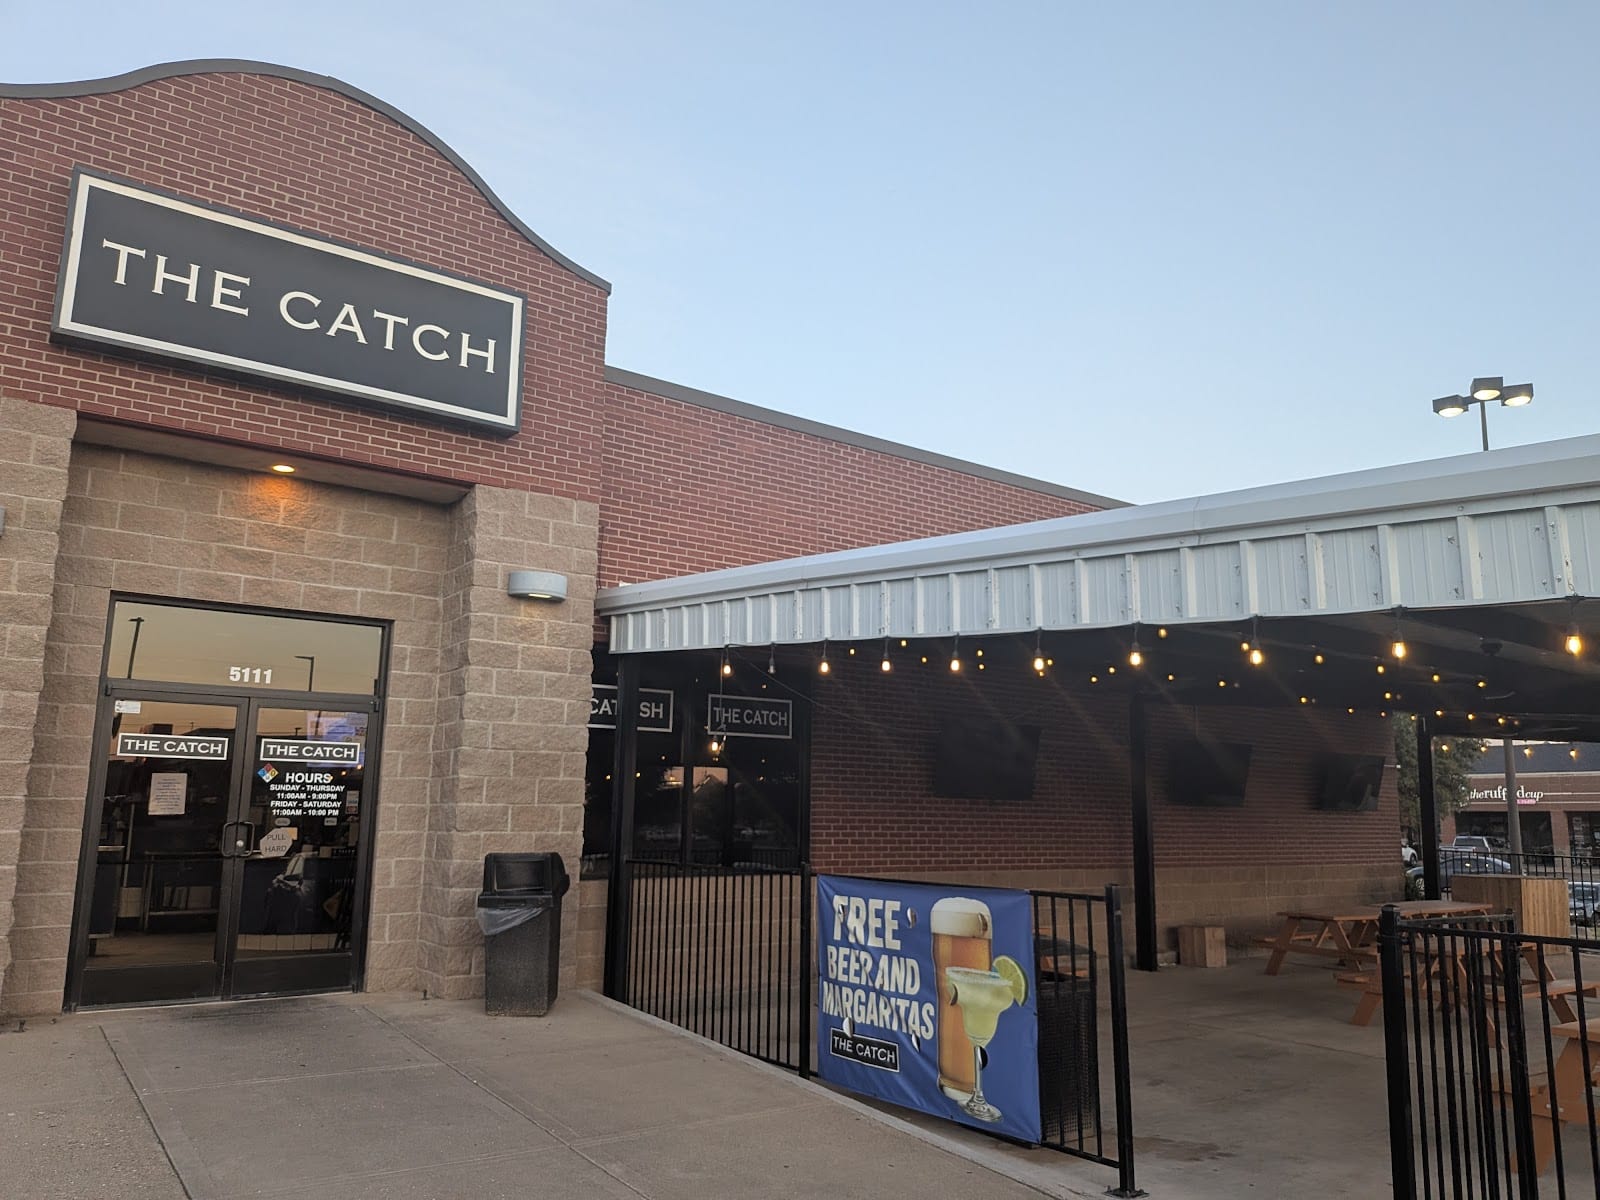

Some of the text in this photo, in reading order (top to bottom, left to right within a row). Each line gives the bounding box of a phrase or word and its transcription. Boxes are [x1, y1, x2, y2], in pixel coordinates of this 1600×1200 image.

[102, 238, 497, 374] THE CATCH
[229, 666, 273, 684] 5111
[590, 697, 664, 719] CATSH
[713, 706, 788, 727] THE CATCH
[124, 739, 223, 755] THE CATCH
[266, 744, 355, 759] THE CATCH
[285, 772, 332, 784] HOURS
[306, 784, 345, 792] THURSDAY
[270, 800, 298, 808] FRIDAY
[272, 808, 303, 816] 11:00AM
[264, 845, 287, 853] HARD
[832, 894, 901, 950] FREE
[827, 945, 921, 996] BEER AND
[822, 981, 936, 1040] MARGARITAS
[833, 1036, 896, 1063] THE CATCH
